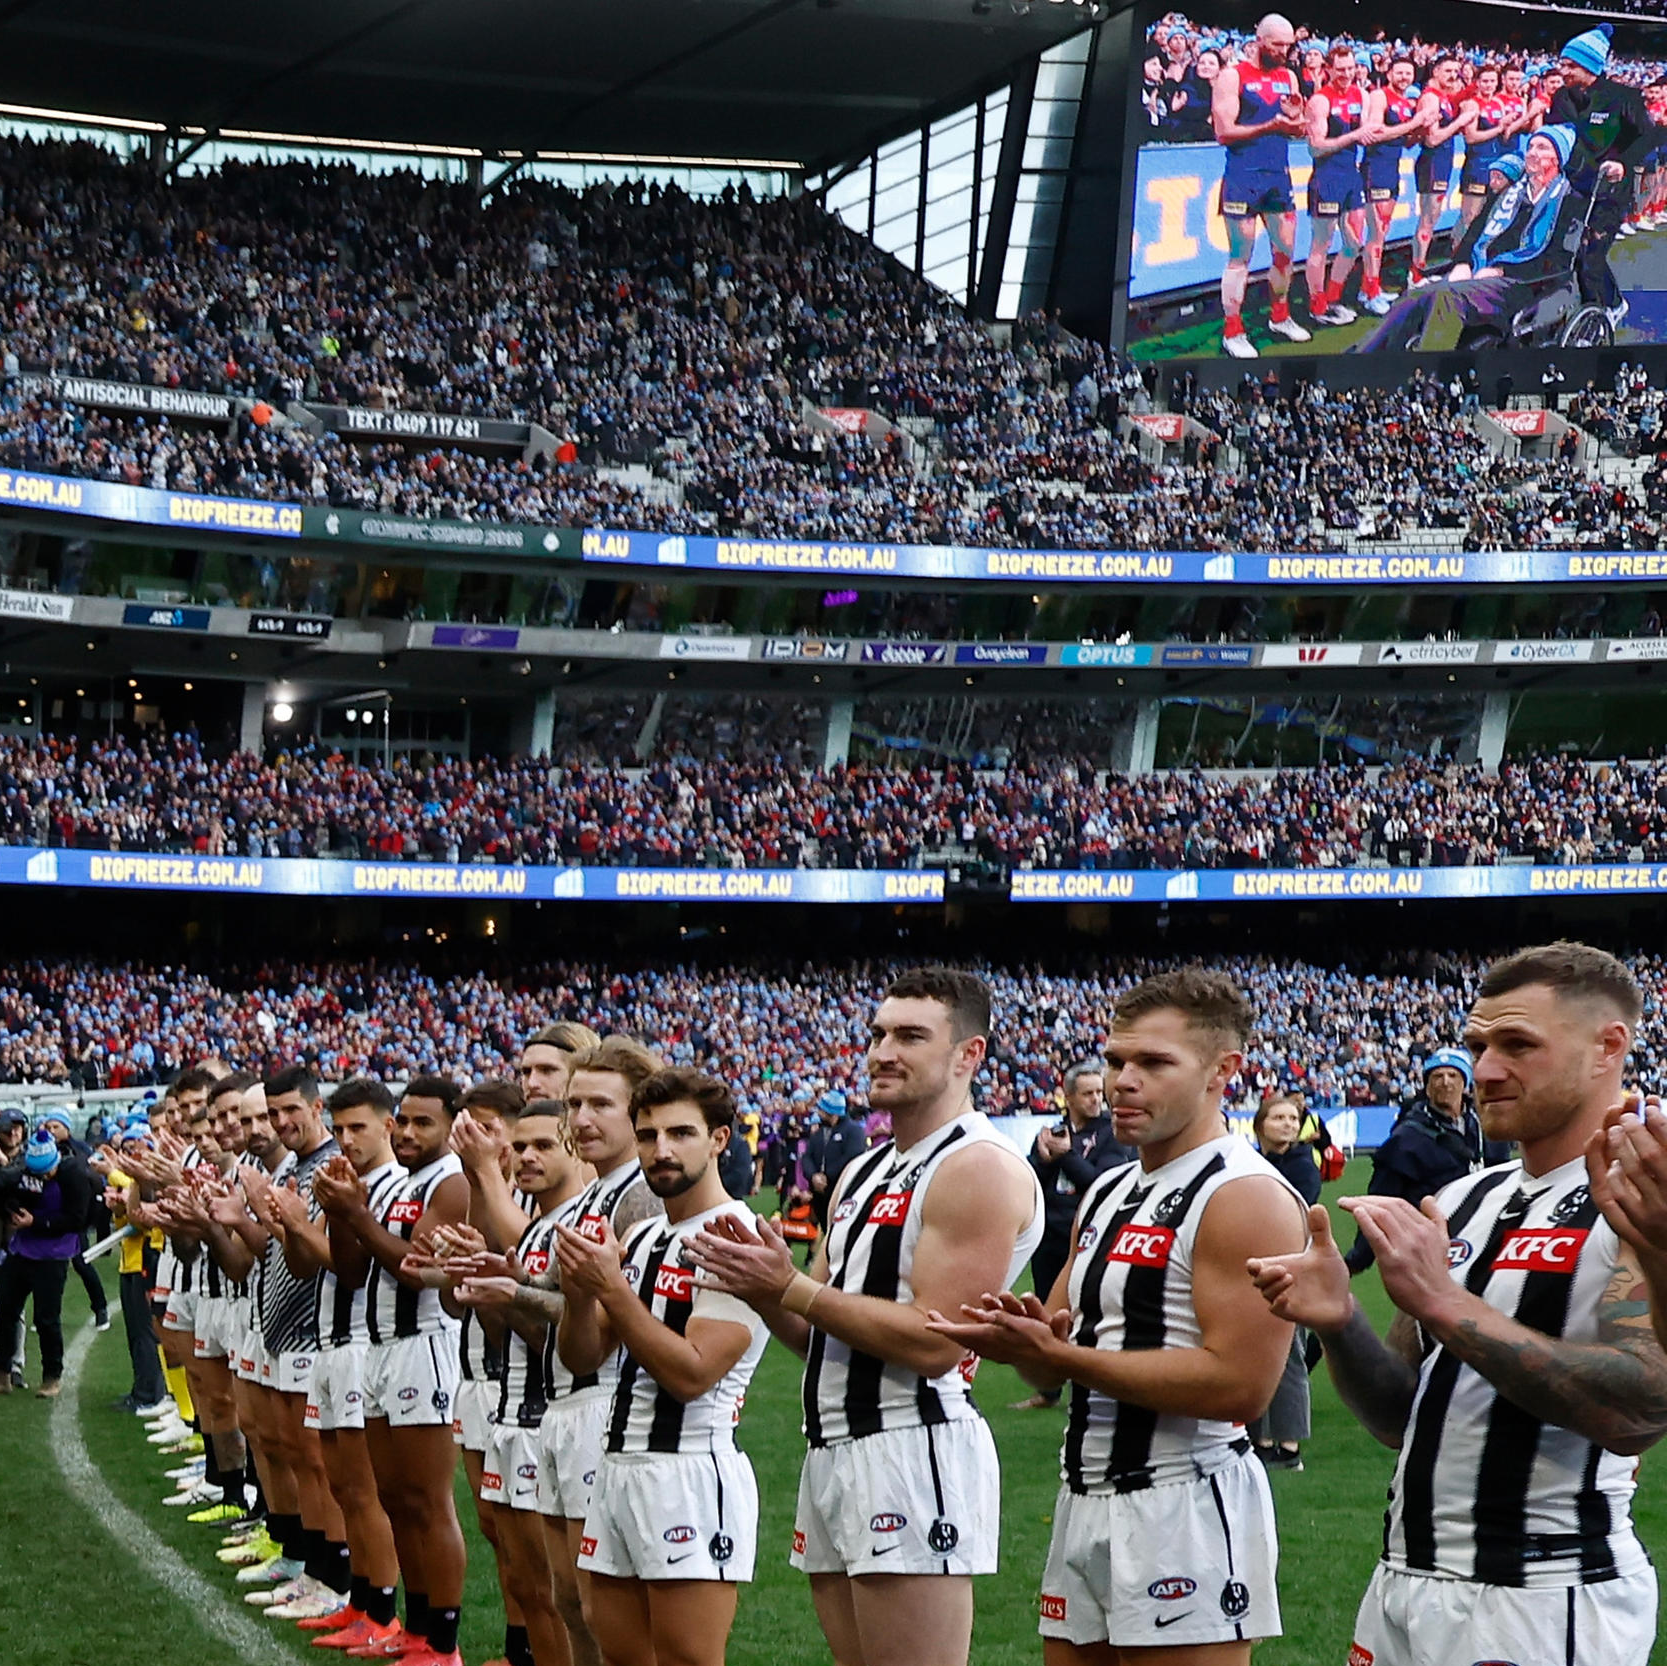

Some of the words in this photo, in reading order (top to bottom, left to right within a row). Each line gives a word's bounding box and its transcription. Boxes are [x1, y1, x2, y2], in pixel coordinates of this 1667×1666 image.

[64, 380, 149, 408] ANTISOCIAL
[151, 390, 230, 417] BEHAVIOUR
[346, 409, 383, 430] TEXT
[717, 542, 896, 569] BIGFREEZE.COM.AU
[987, 553, 1172, 578] BIGFREEZE.COM.AU
[1268, 555, 1464, 579] BIGFREEZE.COM.AU
[40, 601, 64, 617] Sun
[1077, 648, 1135, 664] OPTUS
[90, 856, 263, 888] BIGFREEZE.COM.AU
[353, 865, 525, 894] BIGFREEZE.COM.AU
[1233, 872, 1422, 896] BIGFREEZE.COM.AU
[617, 872, 792, 897] BIGFREEZE.COM.AU
[1112, 1231, 1165, 1259] KFC
[1497, 1238, 1575, 1262] KFC
[655, 1271, 686, 1294] KFC
[667, 1528, 695, 1540] AFL
[873, 1515, 903, 1529] AFL
[1151, 1582, 1194, 1596] AFL
